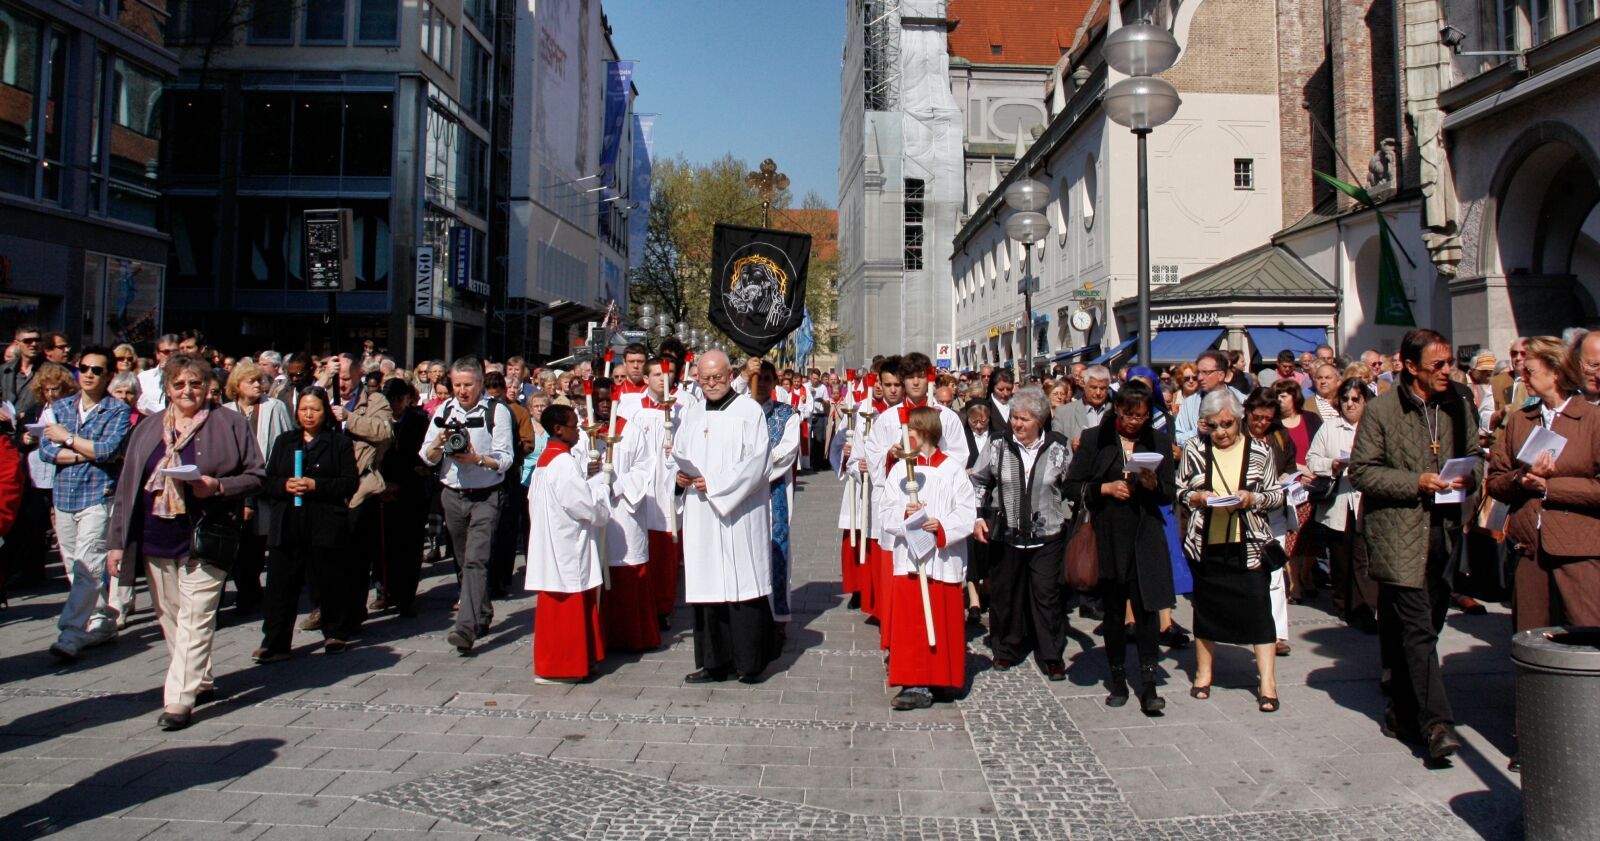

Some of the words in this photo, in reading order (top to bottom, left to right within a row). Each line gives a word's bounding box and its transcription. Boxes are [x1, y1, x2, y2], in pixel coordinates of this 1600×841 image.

[417, 253, 432, 307] MANGO
[1077, 289, 1100, 297] ROLEX
[1157, 312, 1219, 325] BUCHERER
